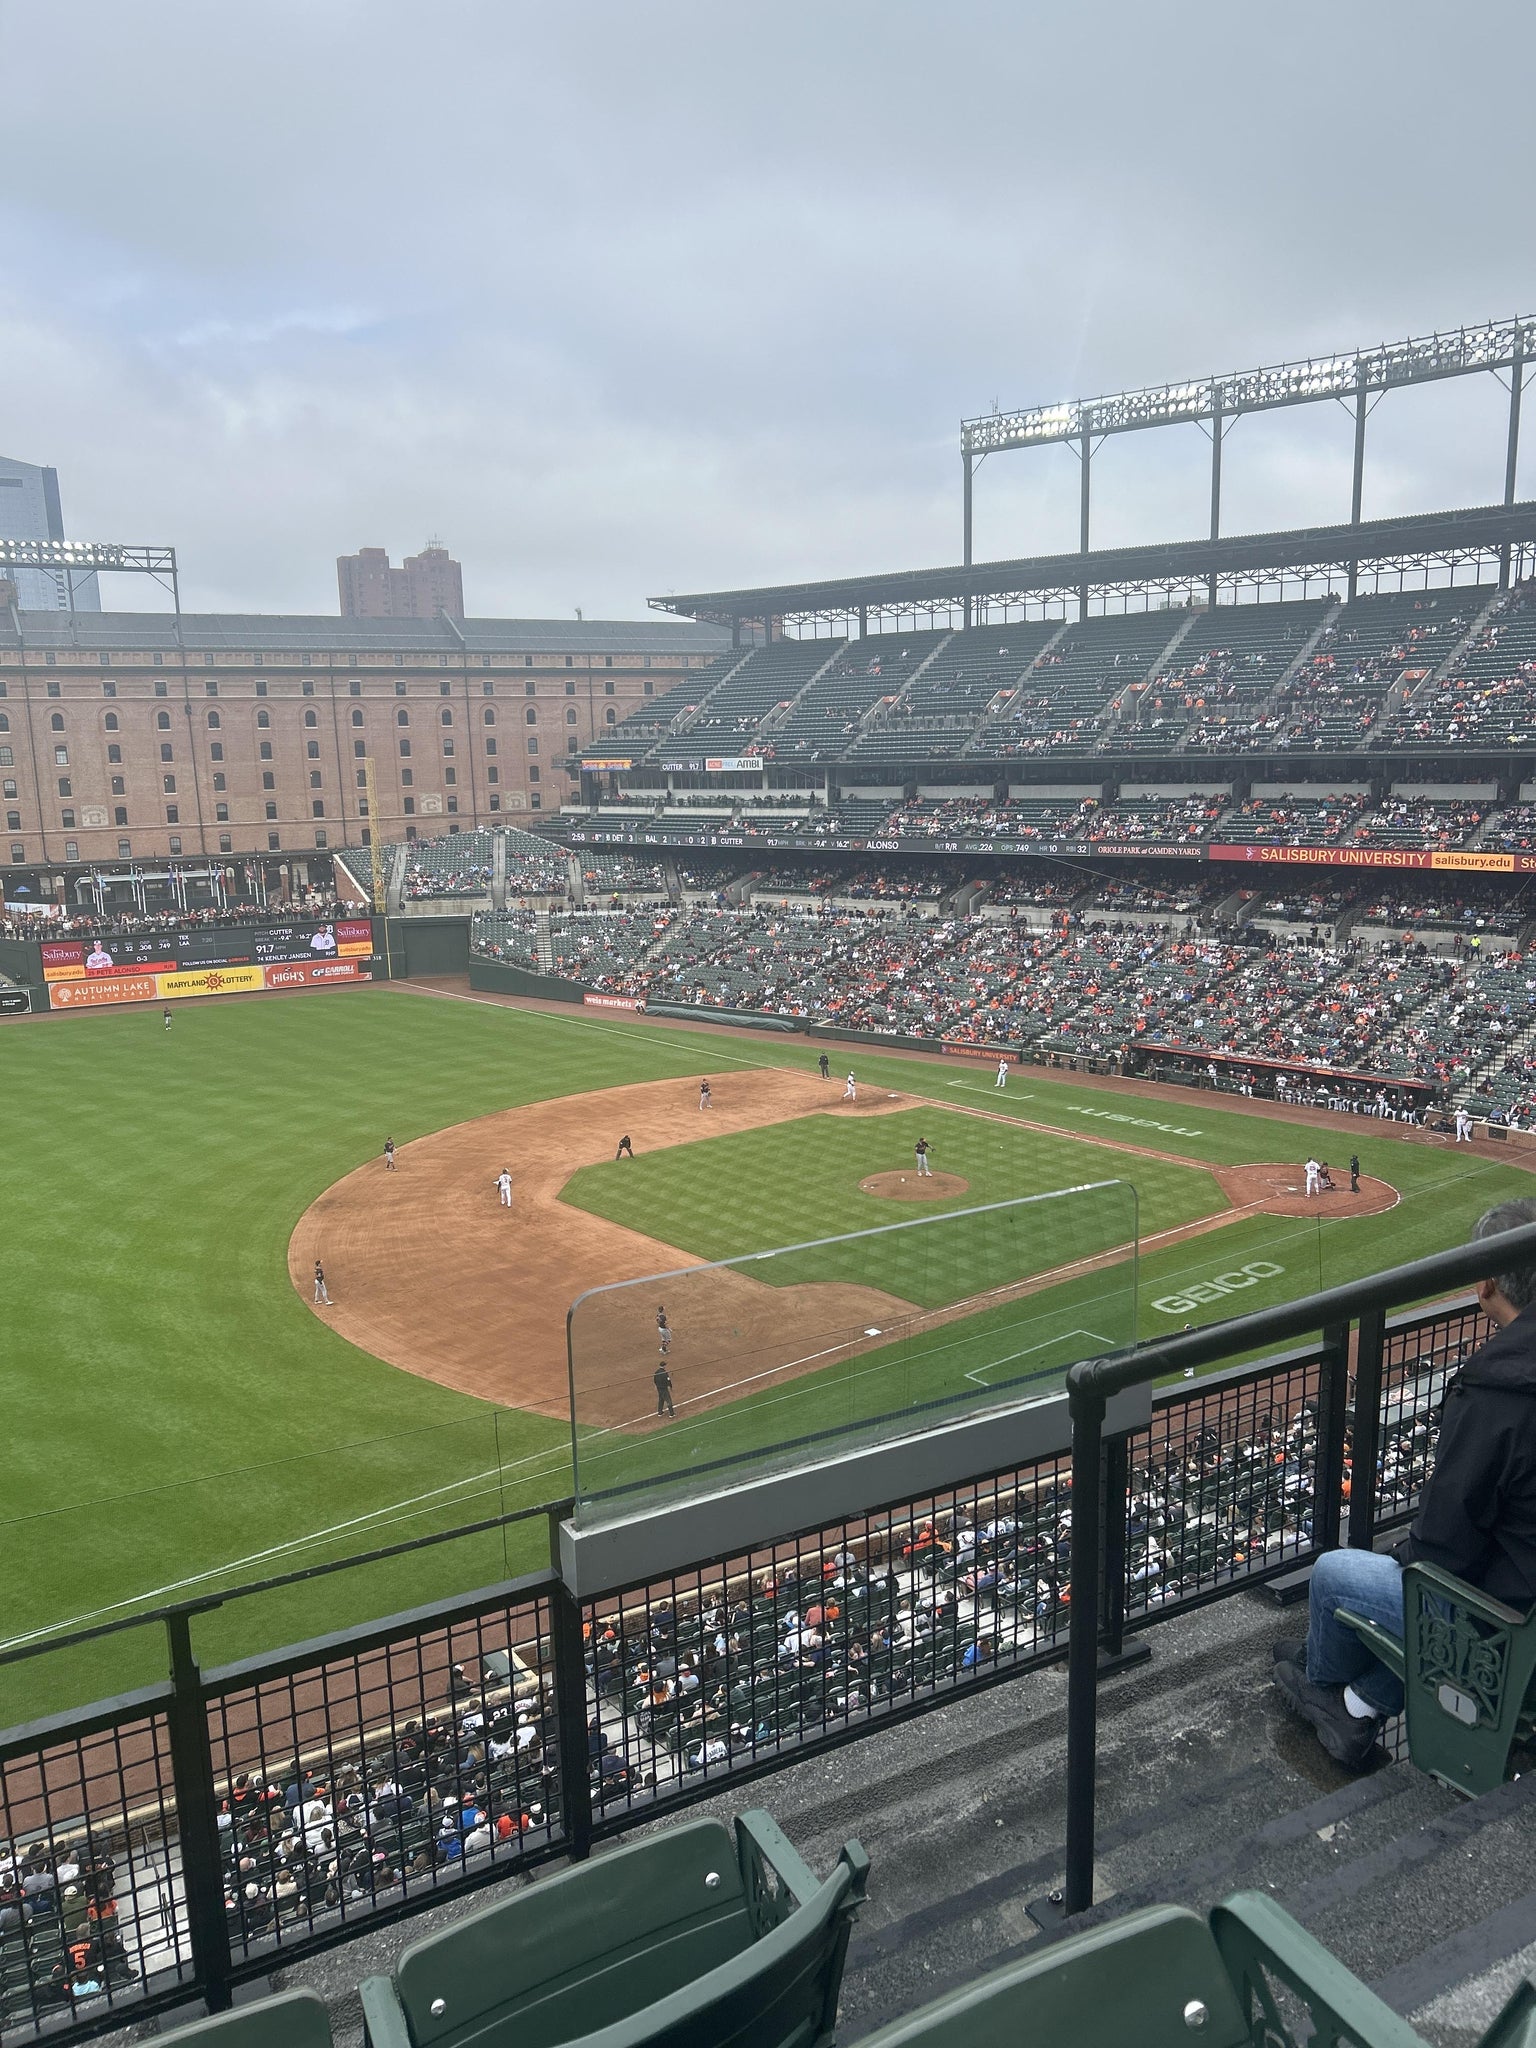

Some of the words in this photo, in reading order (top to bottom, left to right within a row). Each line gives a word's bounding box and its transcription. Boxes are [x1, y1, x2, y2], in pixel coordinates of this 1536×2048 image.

[662, 763, 683, 771] CUTTER
[612, 834, 624, 842] DET
[645, 835, 658, 843] BAL
[866, 840, 899, 849] ALONSO
[1049, 845, 1058, 853] 10
[1097, 846, 1121, 854] ORIOLE
[1123, 847, 1139, 855] PARK
[1148, 847, 1177, 856] CAMDEN
[1178, 848, 1201, 856] YARDS
[1261, 848, 1336, 862] SALISBURY
[1339, 851, 1426, 866] UNIVERSITY
[1434, 856, 1511, 869] salisbury.edu
[337, 927, 370, 938] Salisbury
[256, 944, 274, 954] 91.7
[43, 949, 81, 961] Salisbury
[325, 965, 354, 973] CARROLL
[167, 980, 205, 989] MARYLAND
[222, 975, 253, 984] LOTTERY
[272, 971, 305, 985] HIGH'S
[74, 986, 120, 996] AUTUMN
[124, 981, 150, 991] LAKE
[74, 990, 150, 1001] HEALTHCARE
[586, 996, 601, 1004] weis
[602, 998, 632, 1008] markets
[949, 1047, 981, 1057] SALISBURY
[982, 1050, 1018, 1061] UNIVERSITY
[1151, 1261, 1286, 1313] GEICO
[74, 1951, 86, 1970] 5
